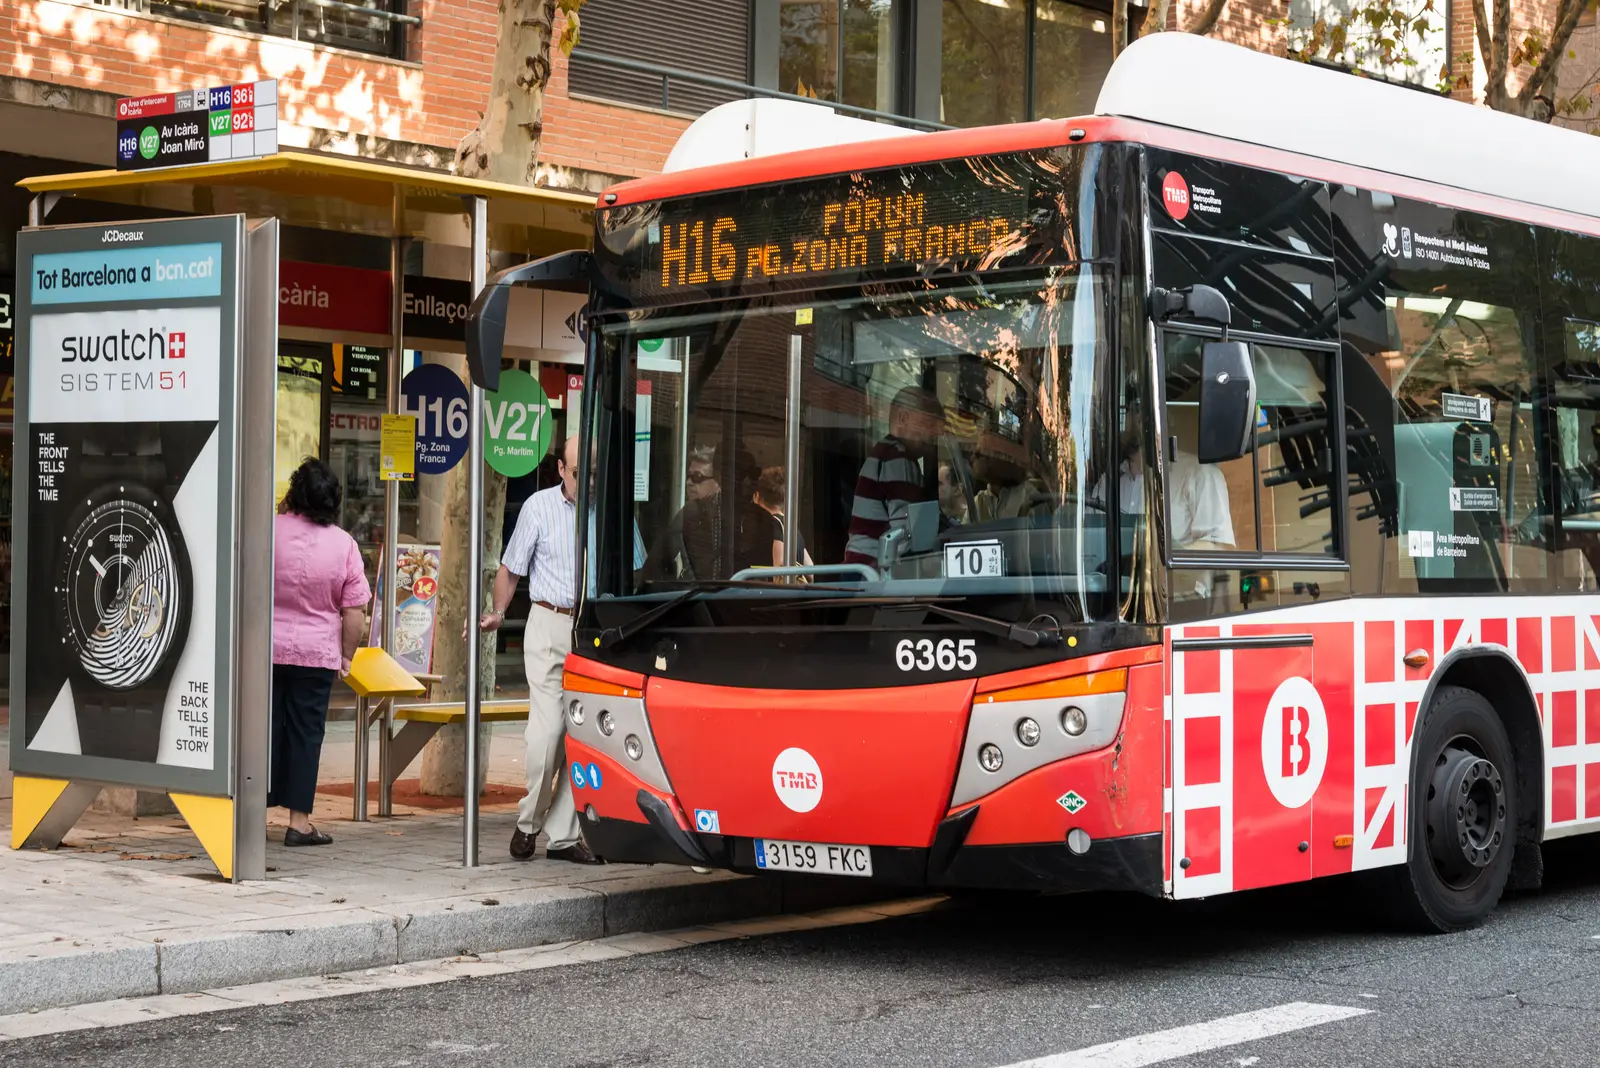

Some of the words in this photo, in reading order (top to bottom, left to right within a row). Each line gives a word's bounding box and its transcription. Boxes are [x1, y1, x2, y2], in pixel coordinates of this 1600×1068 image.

[210, 91, 231, 107] H16
[233, 88, 248, 104] 36
[177, 99, 192, 110] 1764
[211, 114, 231, 131] V27
[233, 112, 249, 130] 92
[161, 125, 173, 139] Av
[174, 122, 199, 137] Icària
[119, 137, 138, 152] H16
[141, 135, 159, 149] V27
[161, 140, 183, 154] Joan
[184, 136, 205, 151] Miró
[1164, 187, 1188, 204] TMB
[1192, 185, 1215, 196] Transports
[824, 193, 924, 236] FORUM
[1193, 202, 1200, 211] de
[1200, 204, 1221, 213] Barcelona
[101, 229, 144, 243] JCDecaux
[1445, 239, 1452, 249] el
[661, 216, 738, 288] H16
[1415, 247, 1425, 258] ISO
[1425, 249, 1440, 261] 14001
[37, 269, 59, 291] Tot
[61, 263, 138, 289] Barcelona
[141, 266, 152, 283] a
[155, 256, 214, 282] bcn.cat
[402, 292, 471, 324] Enllaço
[61, 327, 165, 362] swatch
[60, 372, 154, 392] SISTEM
[159, 370, 187, 390] 51
[400, 394, 468, 439] H16
[484, 399, 546, 442] V27
[38, 432, 55, 445] THE
[38, 447, 69, 459] FRONT
[415, 441, 429, 453] Pg.
[430, 442, 450, 452] Zona
[493, 445, 506, 457] Pg.
[38, 461, 65, 473] TELLS
[38, 475, 55, 487] THE
[38, 489, 59, 501] TIME
[108, 533, 134, 543] swatch
[1437, 531, 1447, 543] Àrea
[1448, 534, 1479, 545] Metropolitana
[1436, 546, 1443, 557] de
[1443, 546, 1467, 558] Barcelona
[955, 548, 983, 576] 10
[895, 638, 978, 672] 6365
[188, 681, 209, 694] THE
[180, 696, 208, 709] BACK
[178, 710, 209, 723] TELLS
[188, 725, 209, 738] THE
[176, 739, 209, 753] STORY
[1281, 705, 1311, 778] B
[776, 770, 818, 790] TMB
[1061, 796, 1083, 809] GNC
[758, 855, 765, 864] E
[768, 843, 817, 869] 3159
[828, 846, 866, 872] FKC
